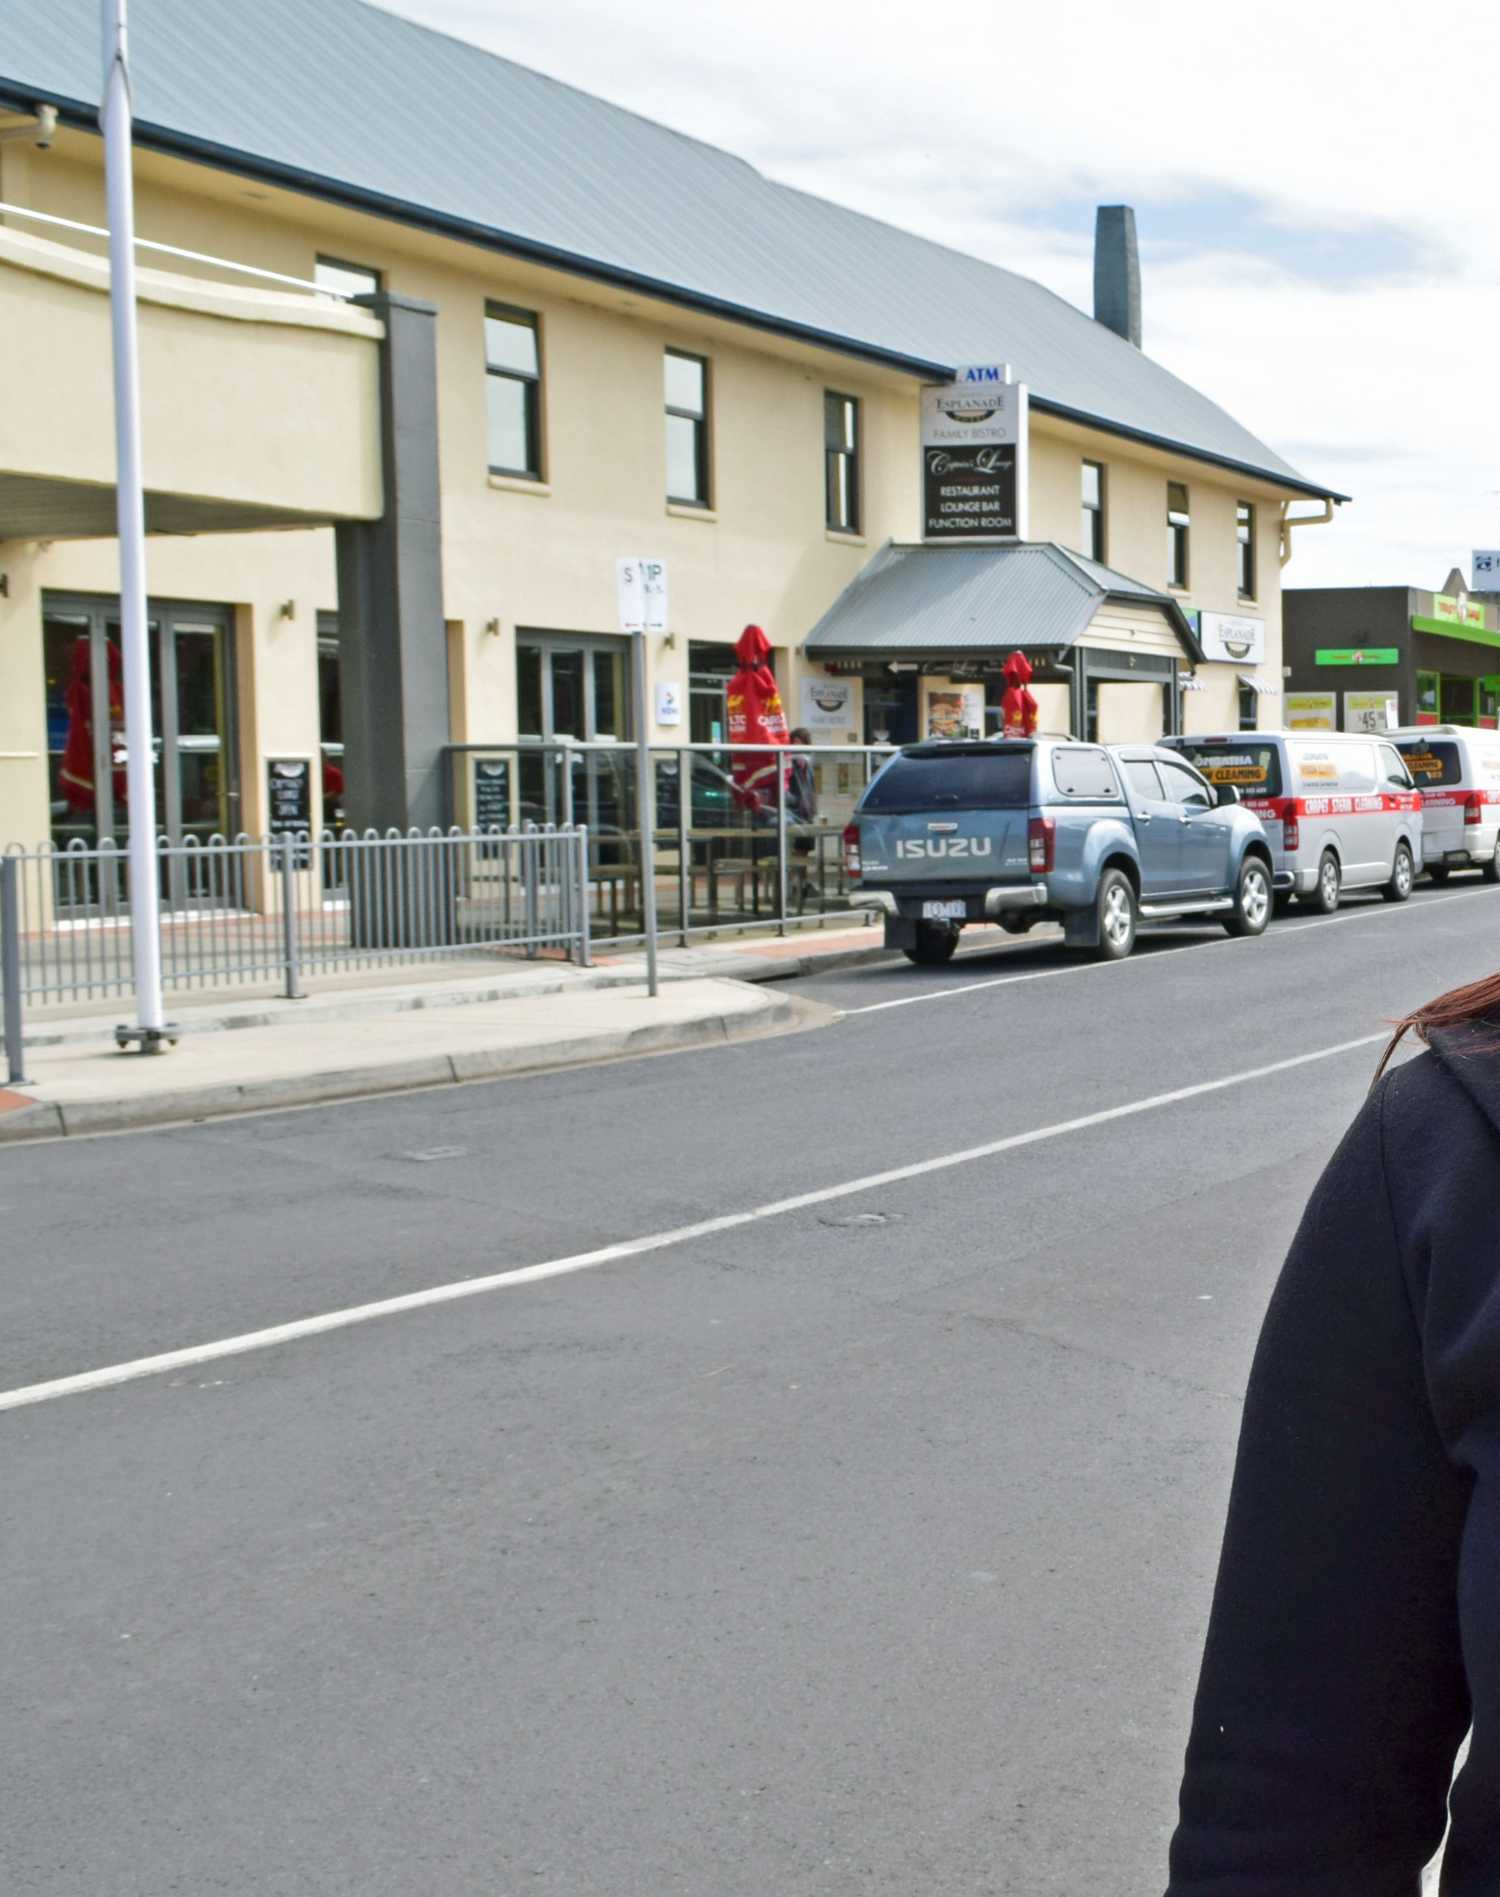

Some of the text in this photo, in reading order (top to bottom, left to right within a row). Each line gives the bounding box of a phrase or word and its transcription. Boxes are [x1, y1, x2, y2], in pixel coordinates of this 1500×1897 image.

[965, 367, 999, 382] ATM
[940, 485, 1001, 497] RESTAURANT
[940, 501, 1001, 512] LOUNGE BAR
[928, 517, 1012, 529] FUNCTION ROOM
[1215, 769, 1261, 780] CLEANING
[896, 836, 992, 859] ISUZU
